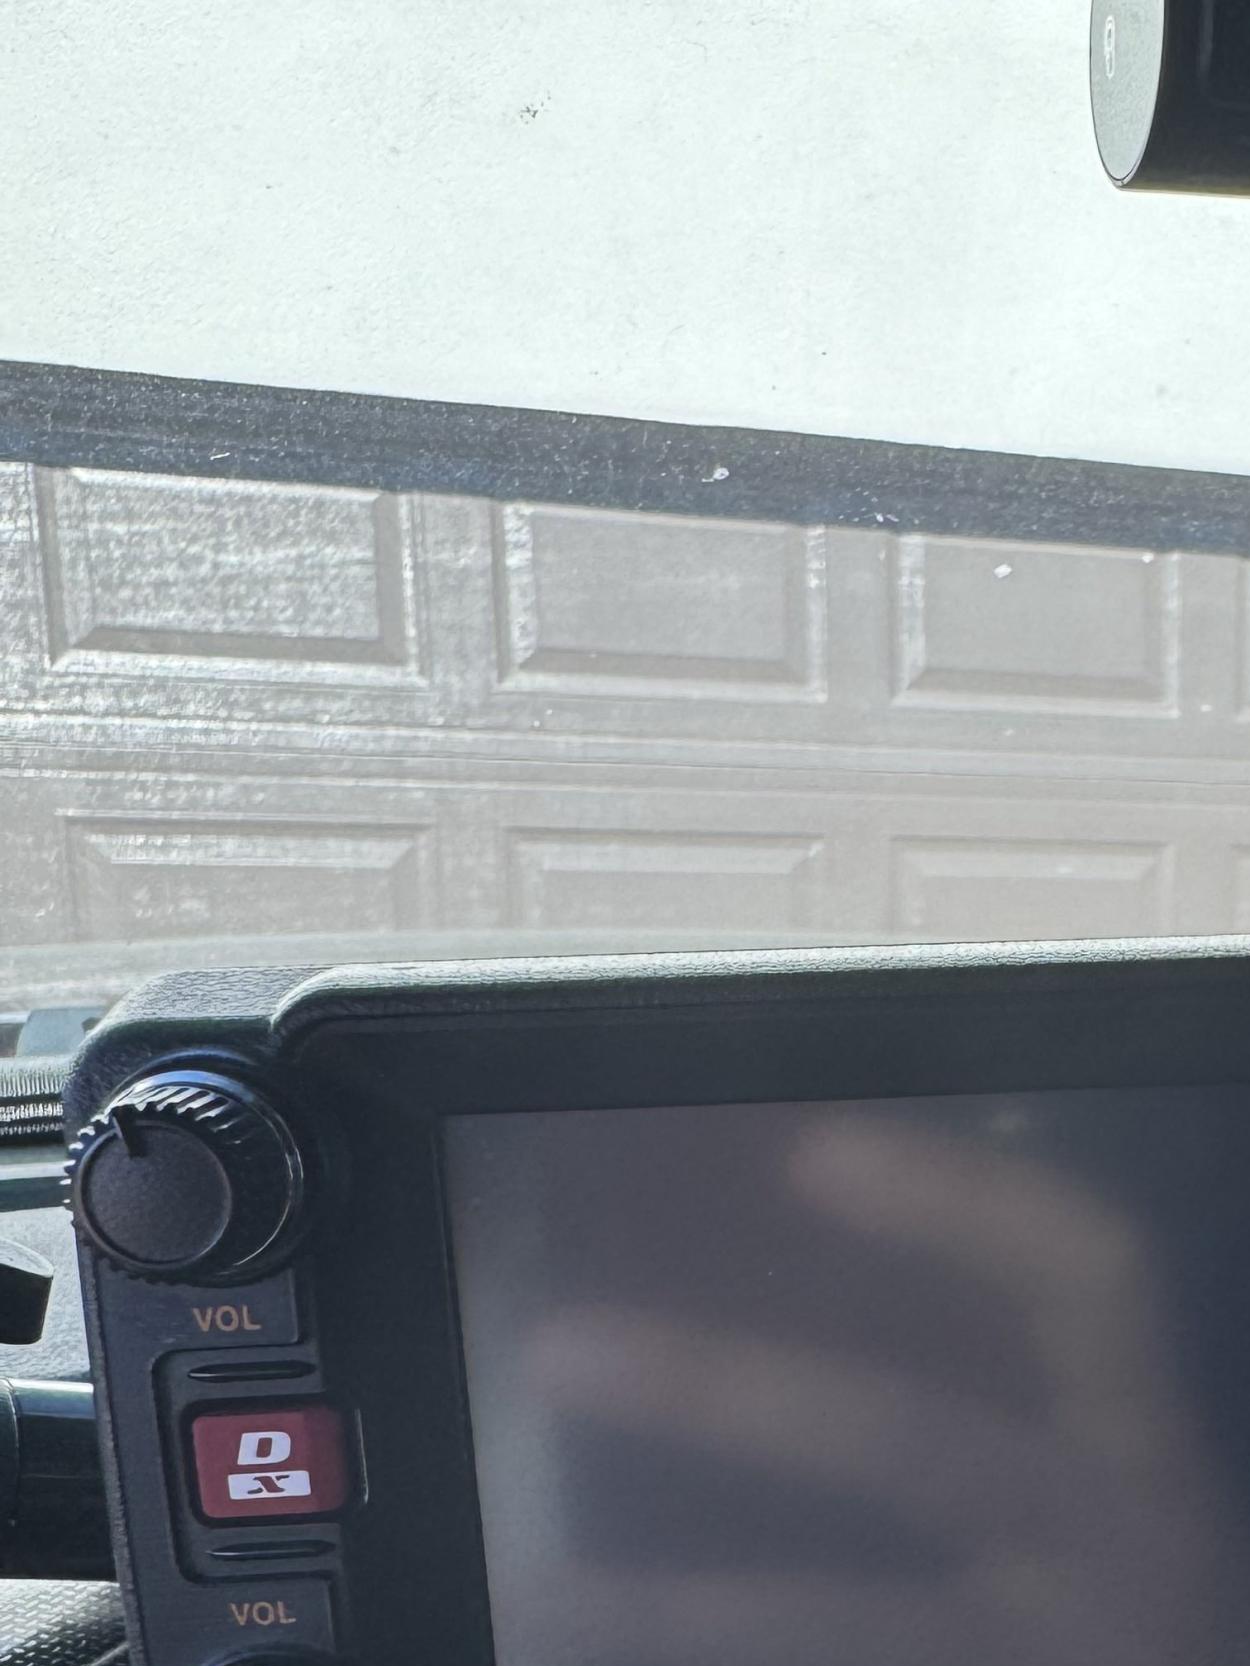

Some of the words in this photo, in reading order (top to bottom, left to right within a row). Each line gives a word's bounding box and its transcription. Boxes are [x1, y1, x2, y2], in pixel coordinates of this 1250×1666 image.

[192, 1305, 262, 1332] VOL
[237, 1430, 292, 1466] D
[229, 1600, 297, 1626] VOL
